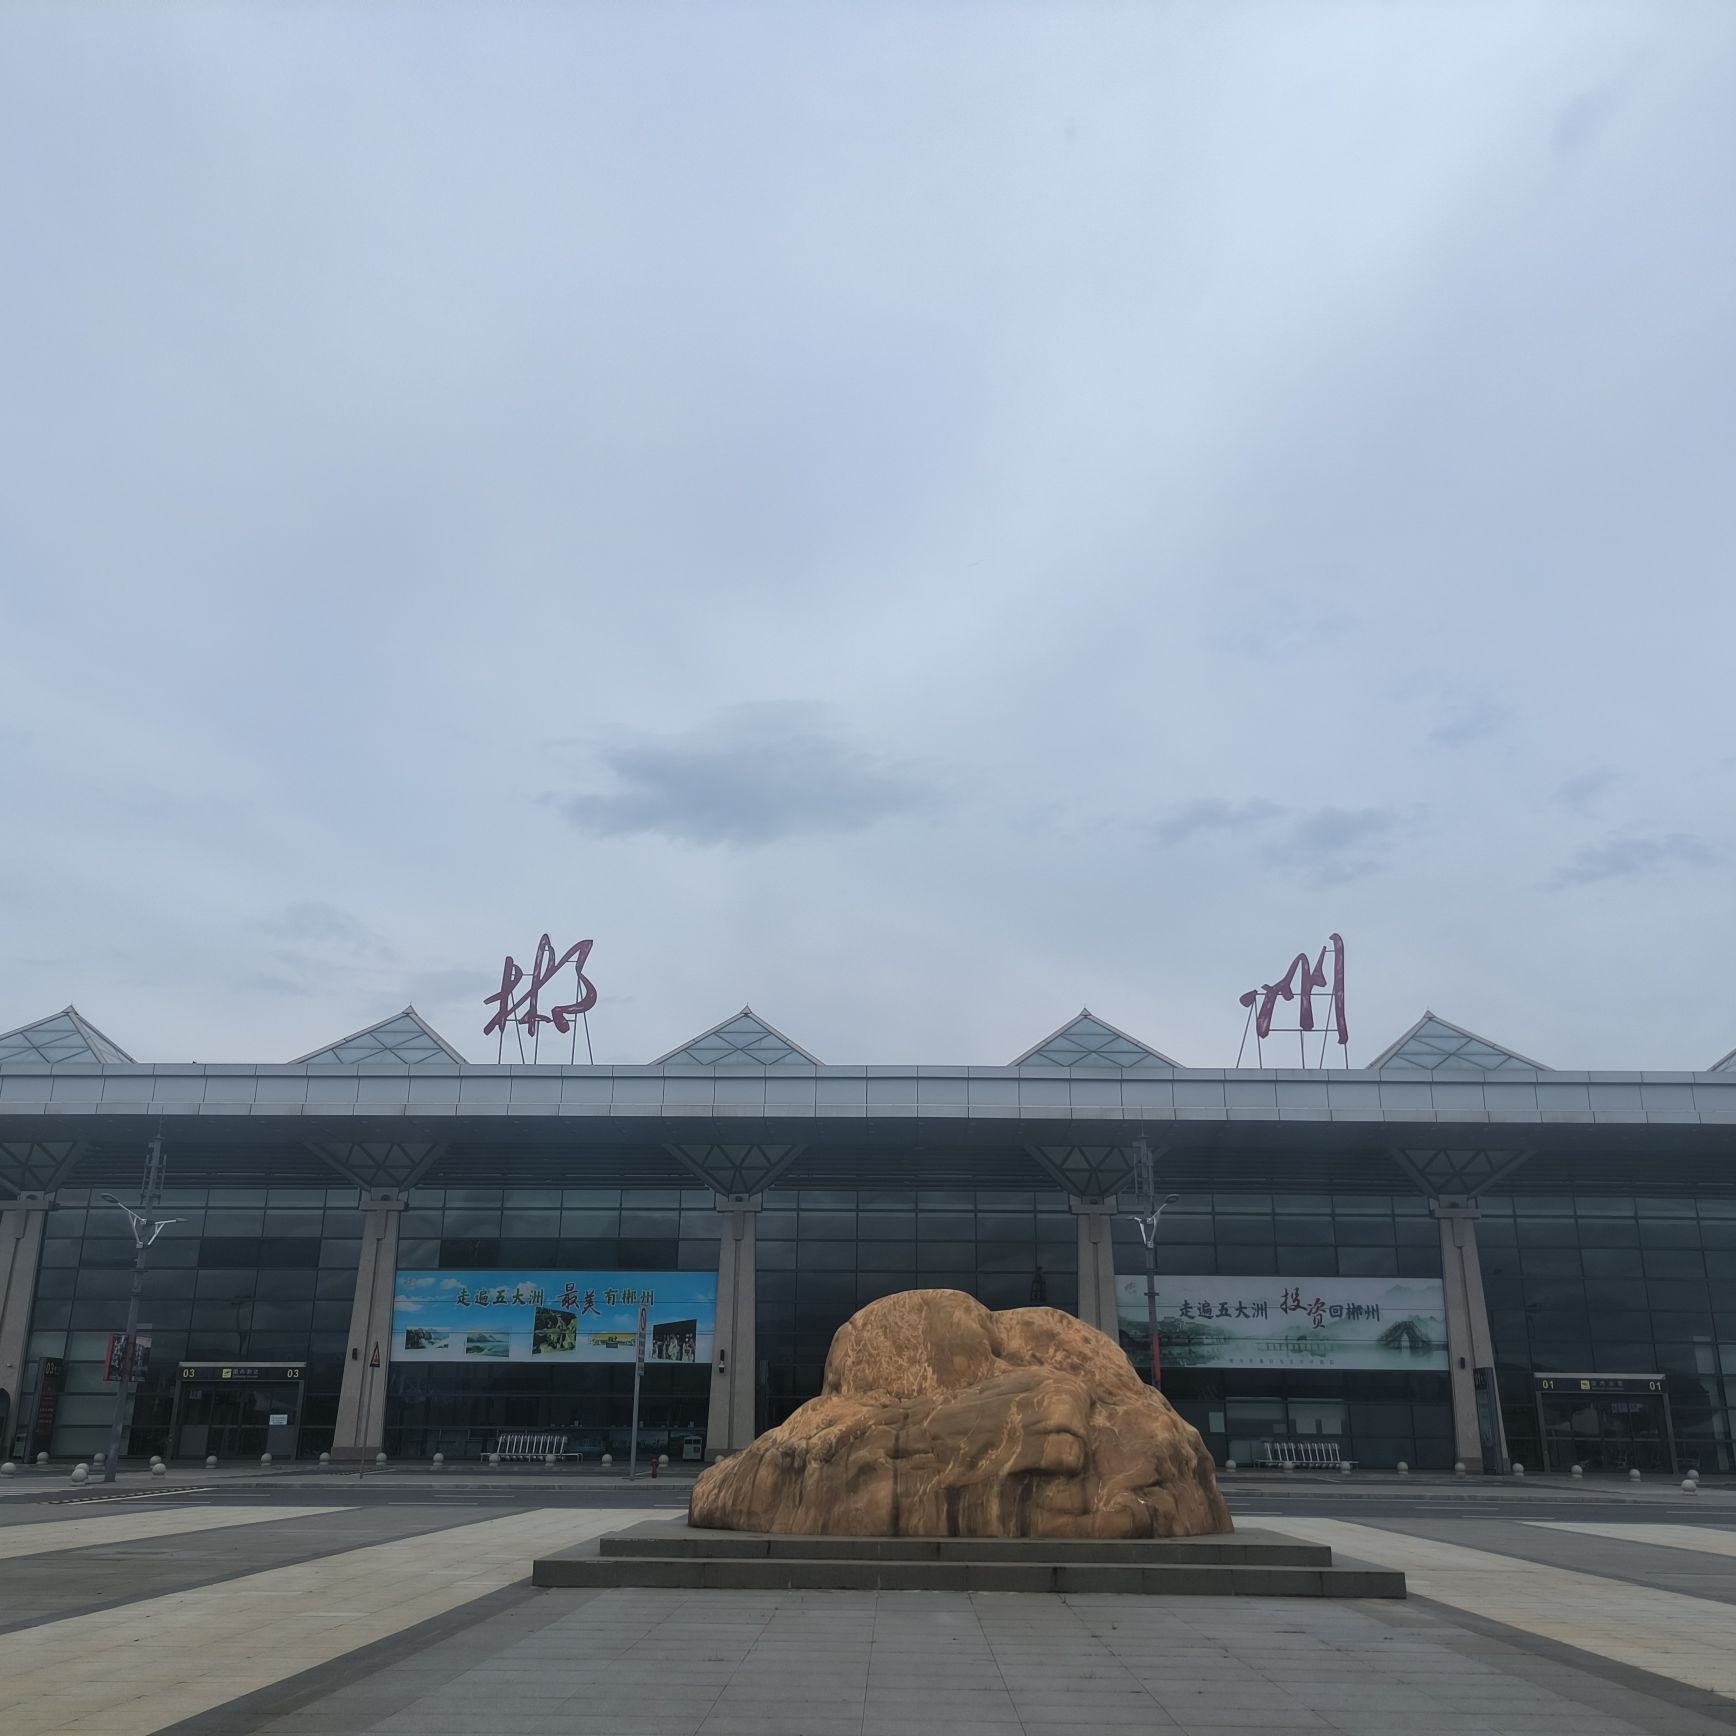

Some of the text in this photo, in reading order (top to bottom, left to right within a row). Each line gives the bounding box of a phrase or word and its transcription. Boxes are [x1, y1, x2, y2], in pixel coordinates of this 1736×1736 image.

[1239, 933, 1348, 1044] 州
[456, 1282, 655, 1316] 走遍五大洲 最美有郴州
[1179, 1287, 1380, 1329] 走遍五大洲 投资回郴州
[182, 1369, 195, 1378] 03
[287, 1369, 299, 1378] 03
[1542, 1379, 1554, 1389] 01
[1649, 1381, 1661, 1391] 01
